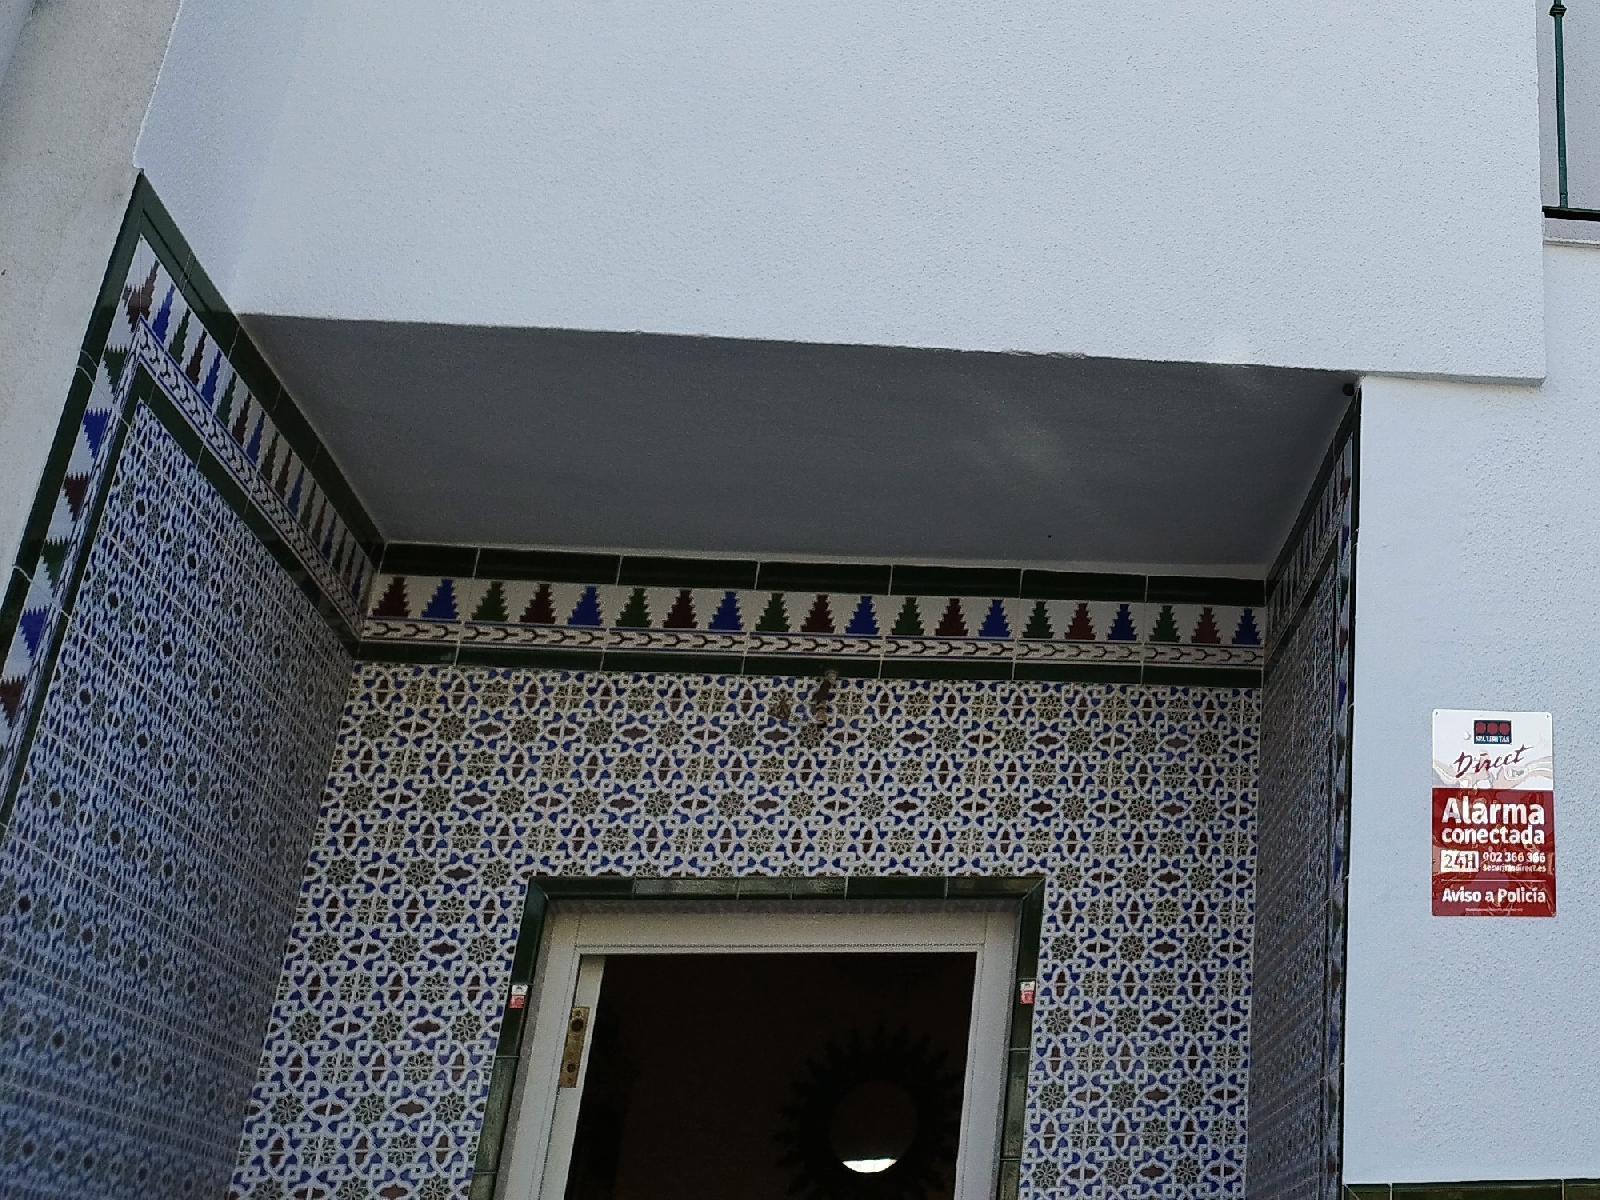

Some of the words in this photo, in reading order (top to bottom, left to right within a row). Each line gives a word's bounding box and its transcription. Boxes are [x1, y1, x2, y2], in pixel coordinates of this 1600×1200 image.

[1453, 744, 1533, 779] Direct
[1441, 796, 1545, 825] Alarma
[1441, 824, 1545, 845] conectada
[1444, 853, 1477, 869] 24H
[1482, 851, 1503, 864] 902
[1442, 886, 1482, 903] Aviso
[1484, 891, 1495, 903] a
[1497, 886, 1546, 903] Policía
